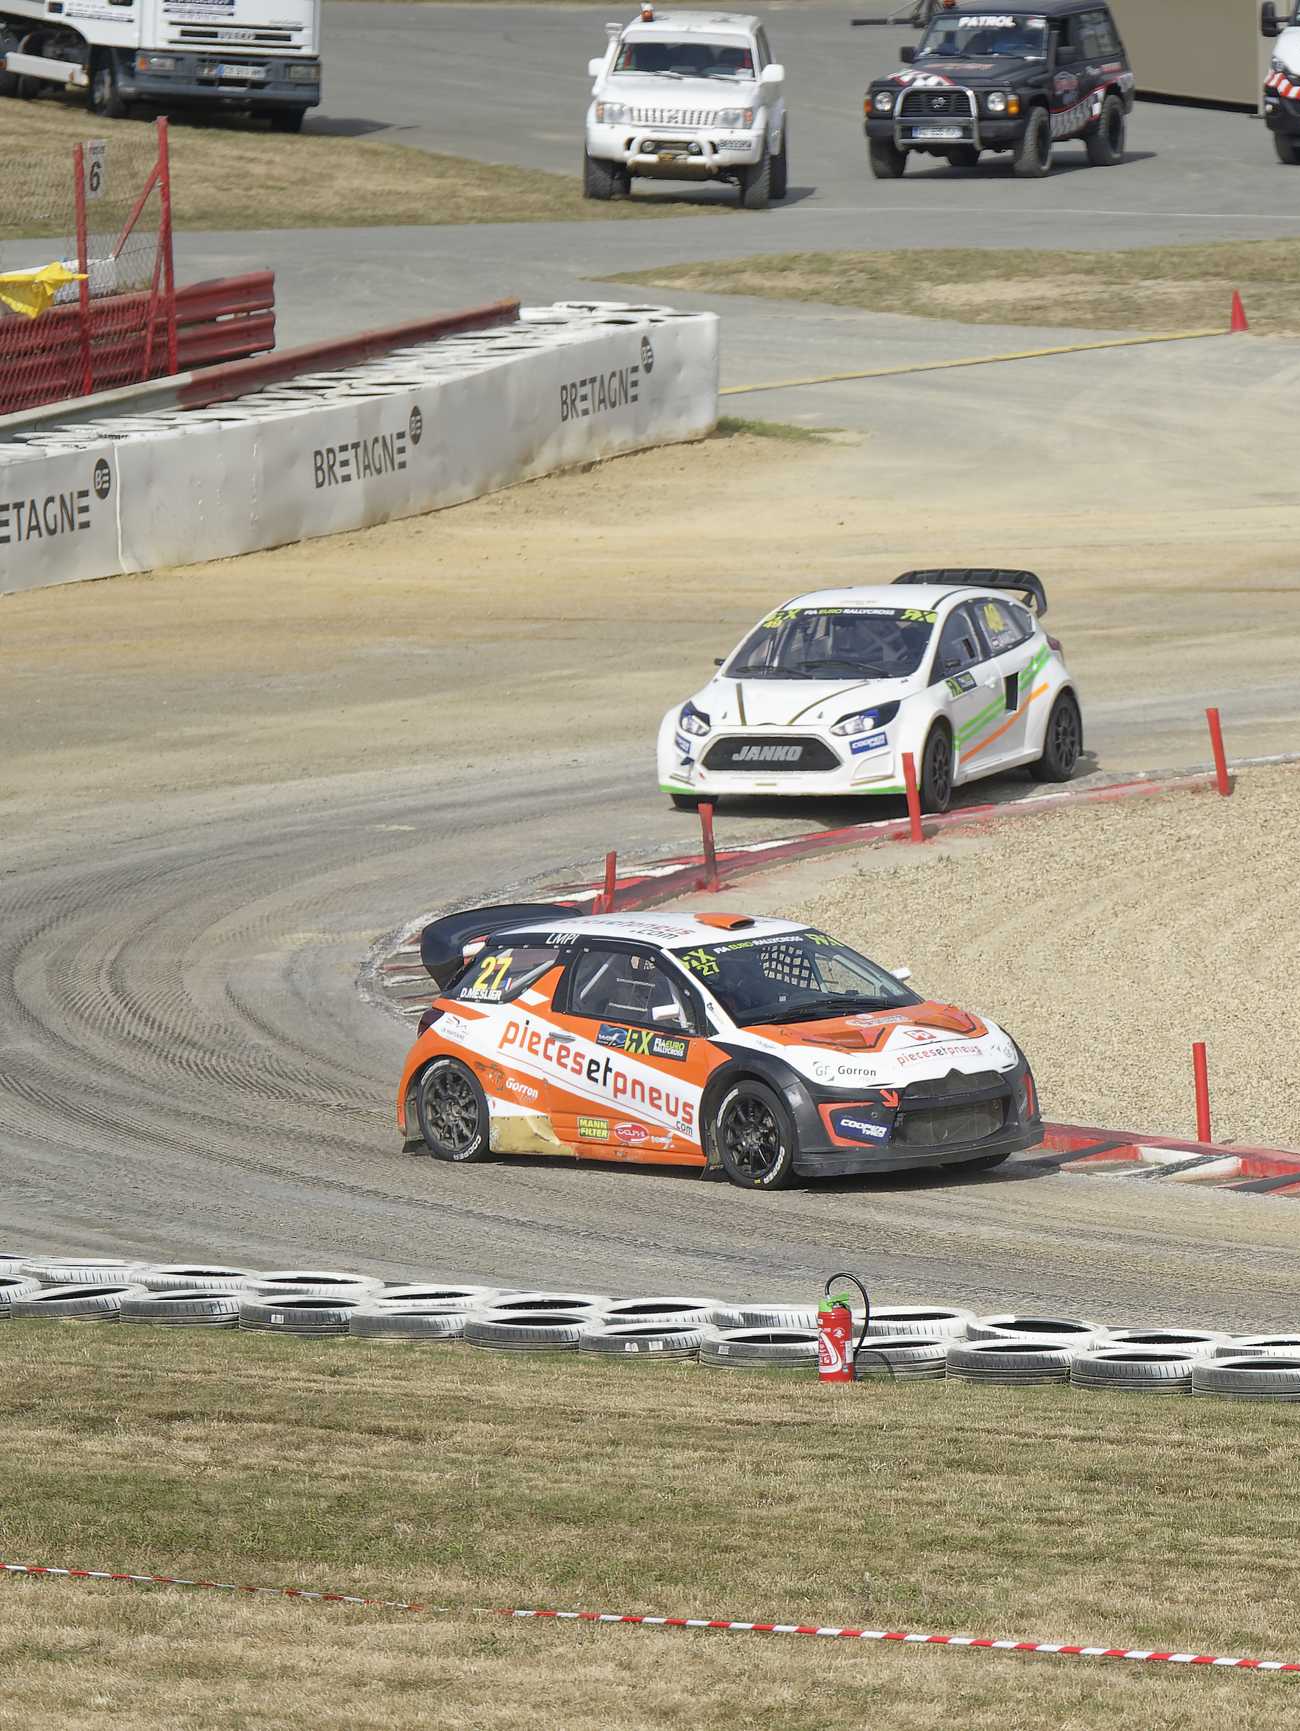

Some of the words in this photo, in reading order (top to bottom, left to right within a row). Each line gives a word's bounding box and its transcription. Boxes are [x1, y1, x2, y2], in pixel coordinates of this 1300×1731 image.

[958, 16, 1016, 28] PATROL
[89, 160, 102, 192] 6
[560, 364, 639, 422] BRETAGNE
[313, 430, 407, 489] BRETAGNE
[732, 745, 803, 761] JANKO
[714, 945, 730, 954] FIA
[729, 941, 753, 950] EURO
[471, 955, 513, 991] 27
[459, 987, 502, 1001] D.MESLIER
[497, 1015, 695, 1126] piecesetpneus
[837, 1065, 877, 1077] Gorron
[505, 1077, 539, 1099] Gorron
[579, 1118, 608, 1130] MANN
[839, 1118, 888, 1133] COOPER
[580, 1126, 608, 1138] FILTER
